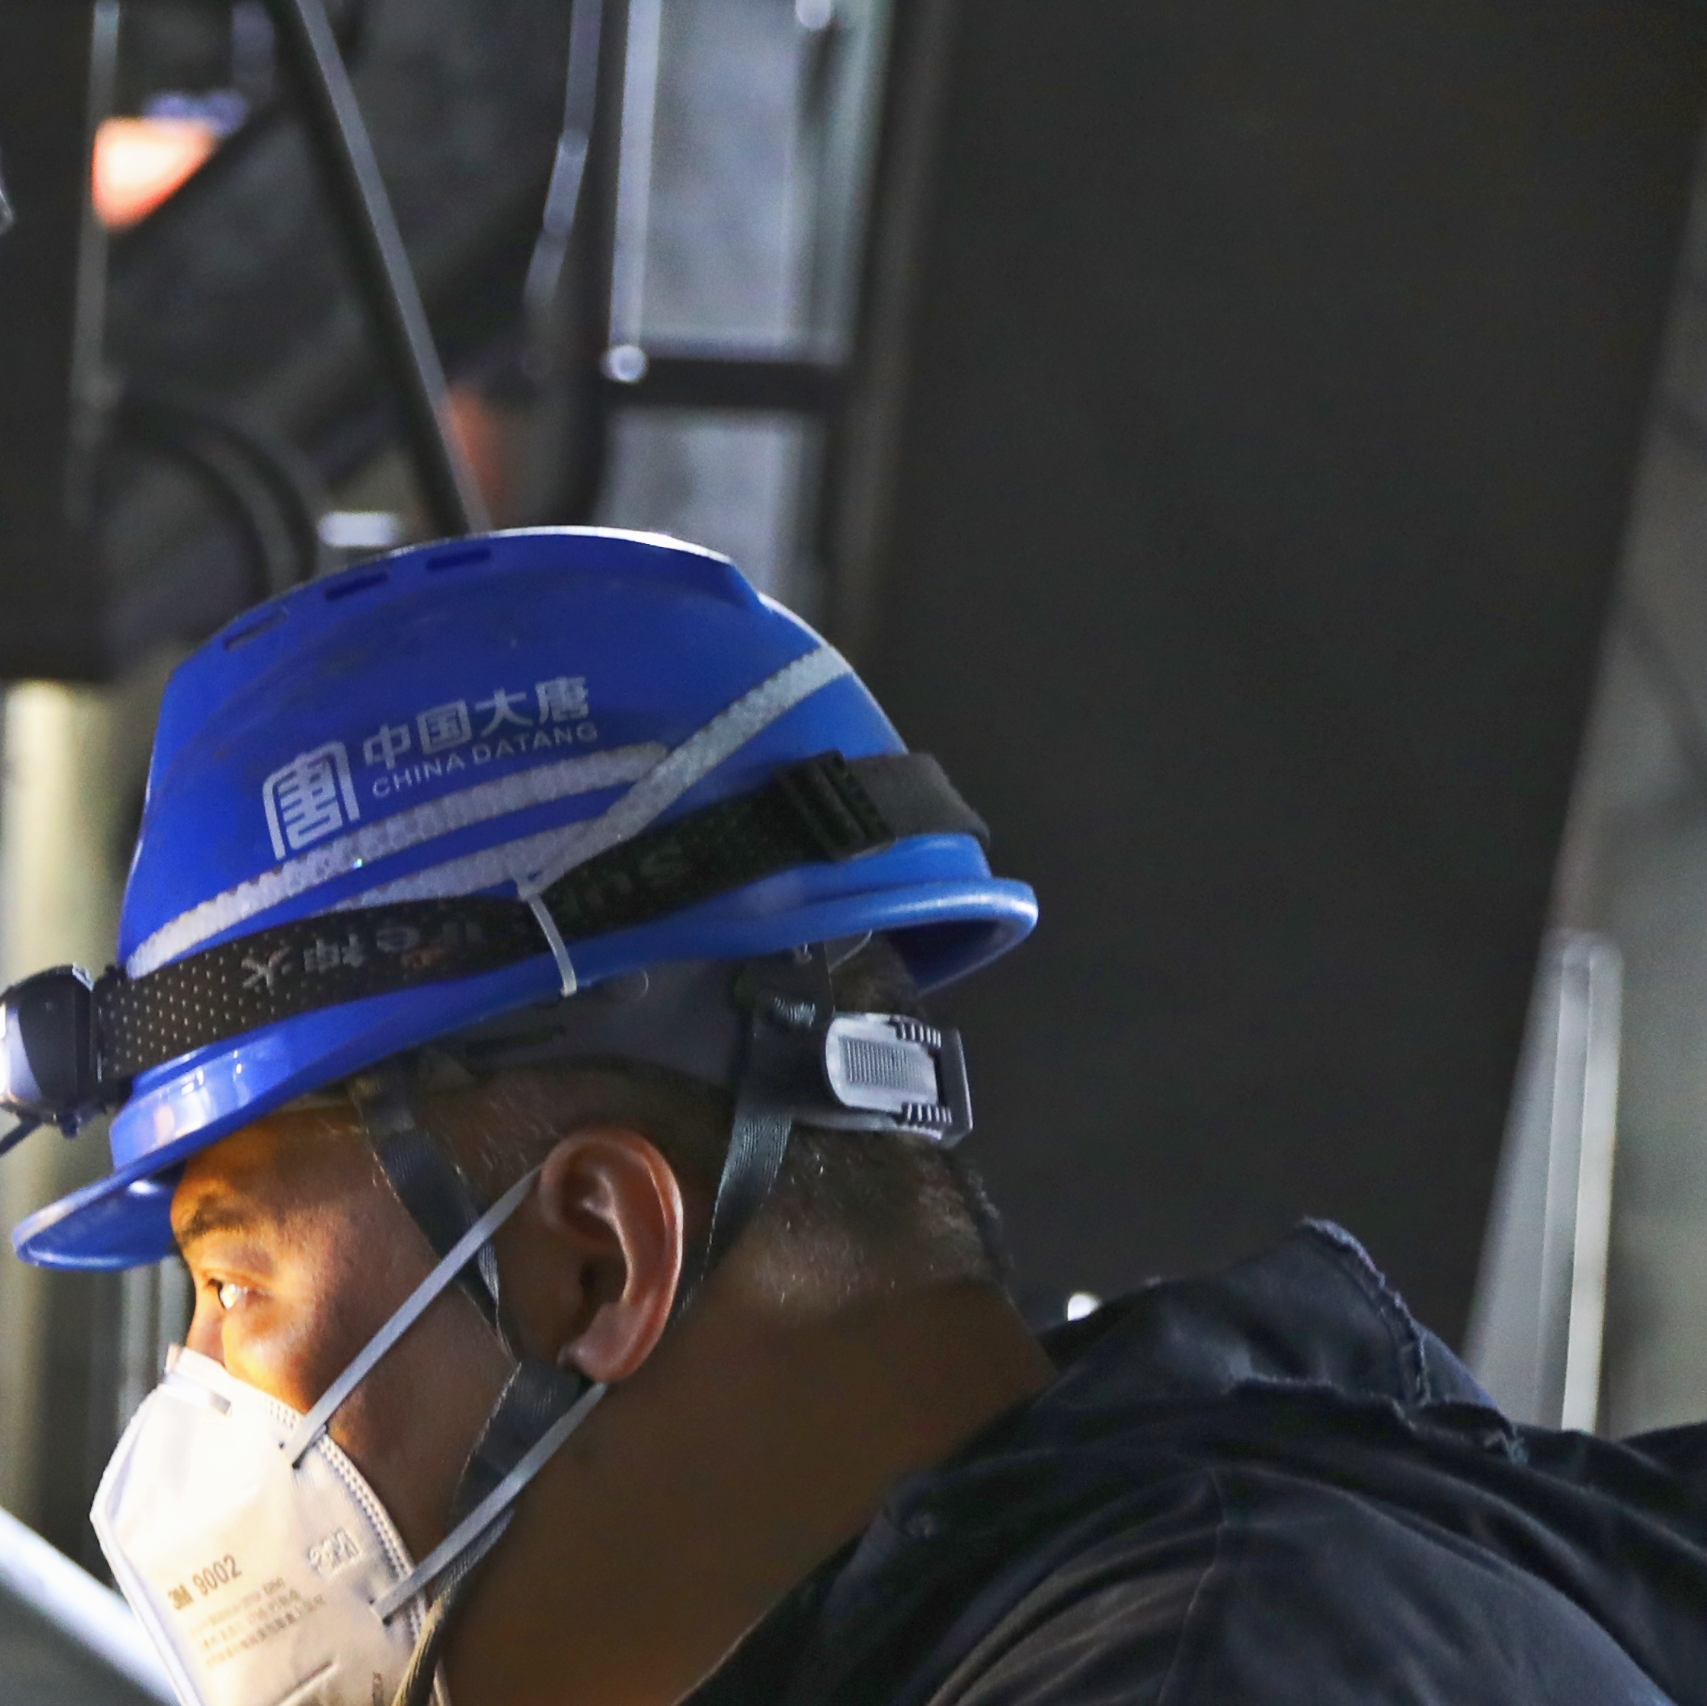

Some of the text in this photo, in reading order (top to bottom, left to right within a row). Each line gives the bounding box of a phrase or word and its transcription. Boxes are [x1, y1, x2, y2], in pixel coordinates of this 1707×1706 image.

[363, 675, 589, 771] 中国大唐
[371, 721, 599, 798] CHINA DATANG
[167, 1553, 242, 1611] 3M 9002
